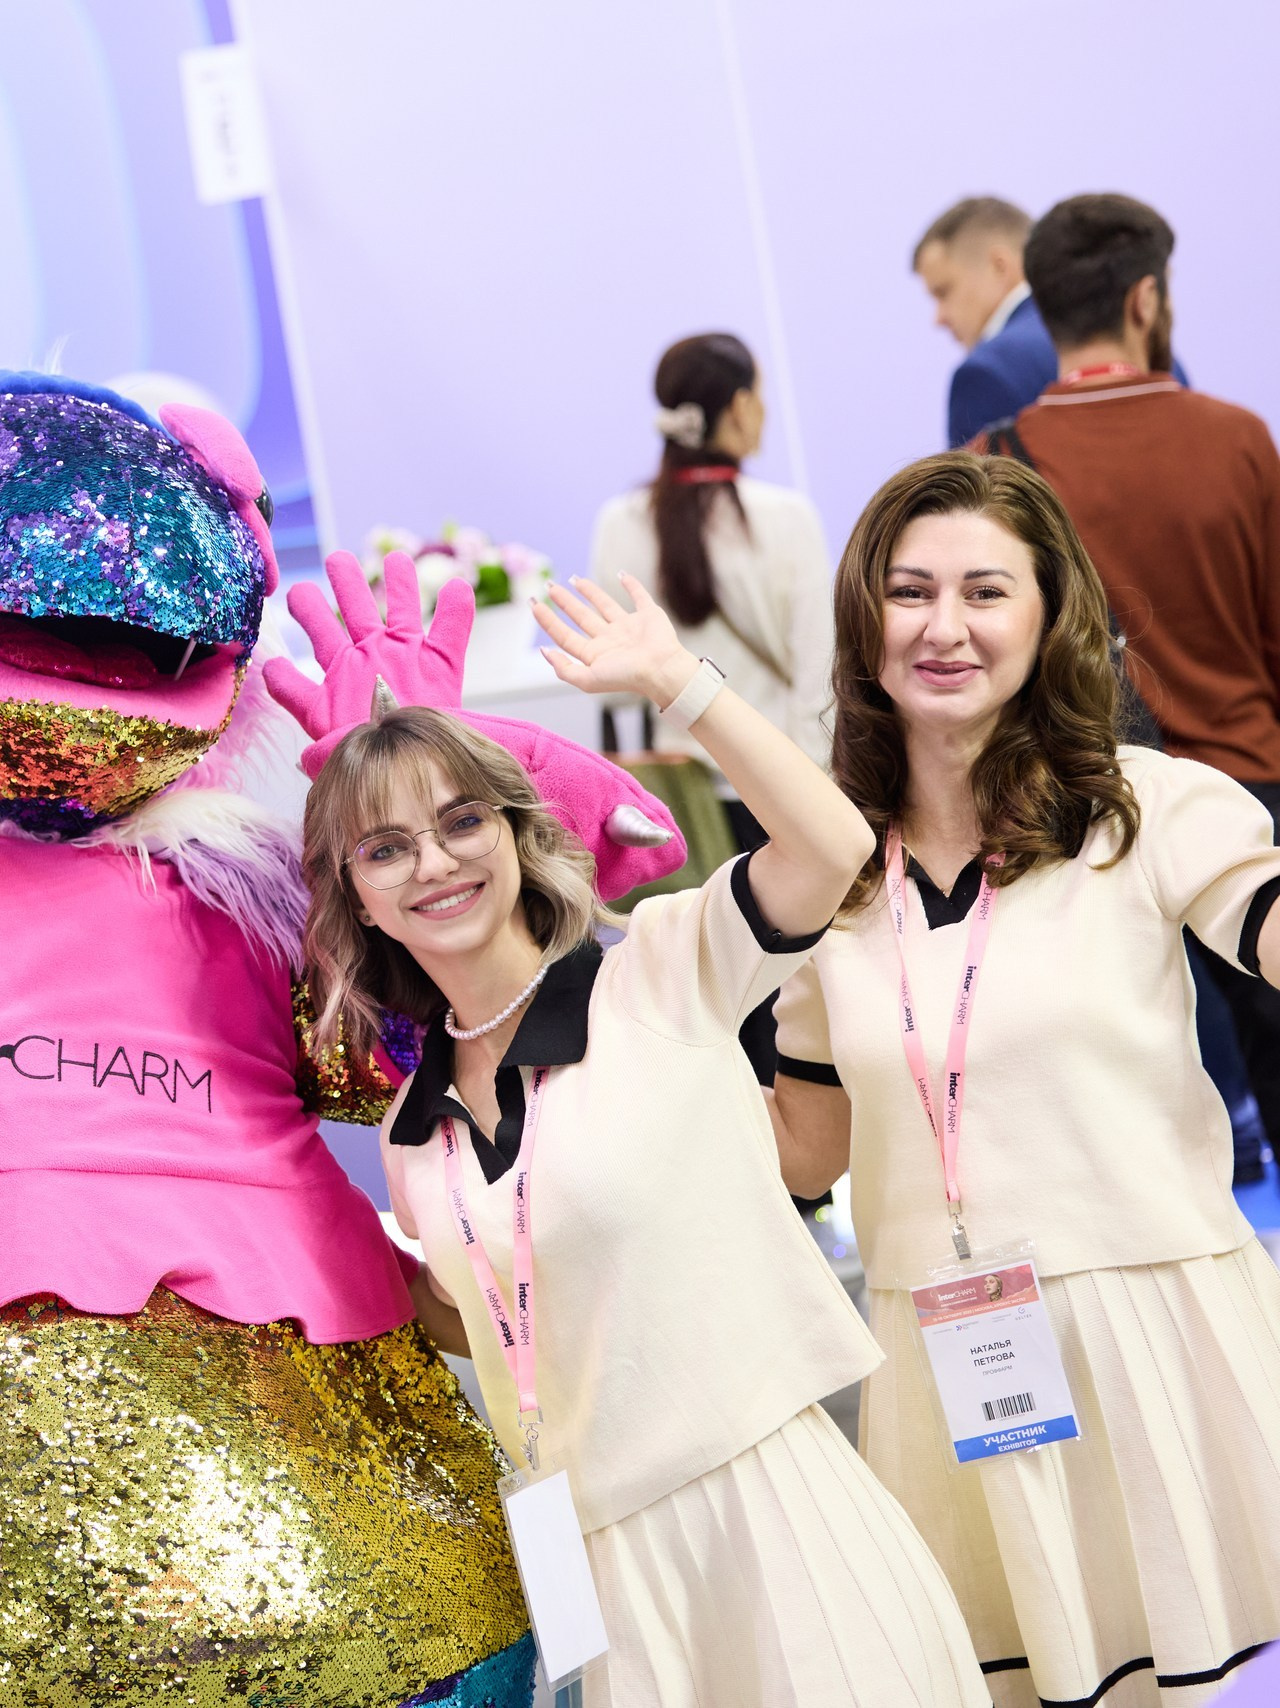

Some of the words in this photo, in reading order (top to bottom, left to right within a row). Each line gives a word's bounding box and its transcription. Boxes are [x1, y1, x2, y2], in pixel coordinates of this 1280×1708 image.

[957, 966, 977, 1026] interCHARM
[527, 1069, 547, 1127] interCHARM
[948, 1072, 961, 1134] interCHARM
[451, 1188, 476, 1246] interCHARM
[516, 1171, 528, 1234] interCHARM
[486, 1287, 516, 1348] interCHARM
[518, 1282, 530, 1346] interCHARM
[970, 1339, 1012, 1356] НАТАЛЬЯ
[973, 1351, 1016, 1367] ПЕТРОВА
[983, 1424, 1047, 1447] УЧАСТНИК
[997, 1438, 1038, 1452] EXHIBITOR
